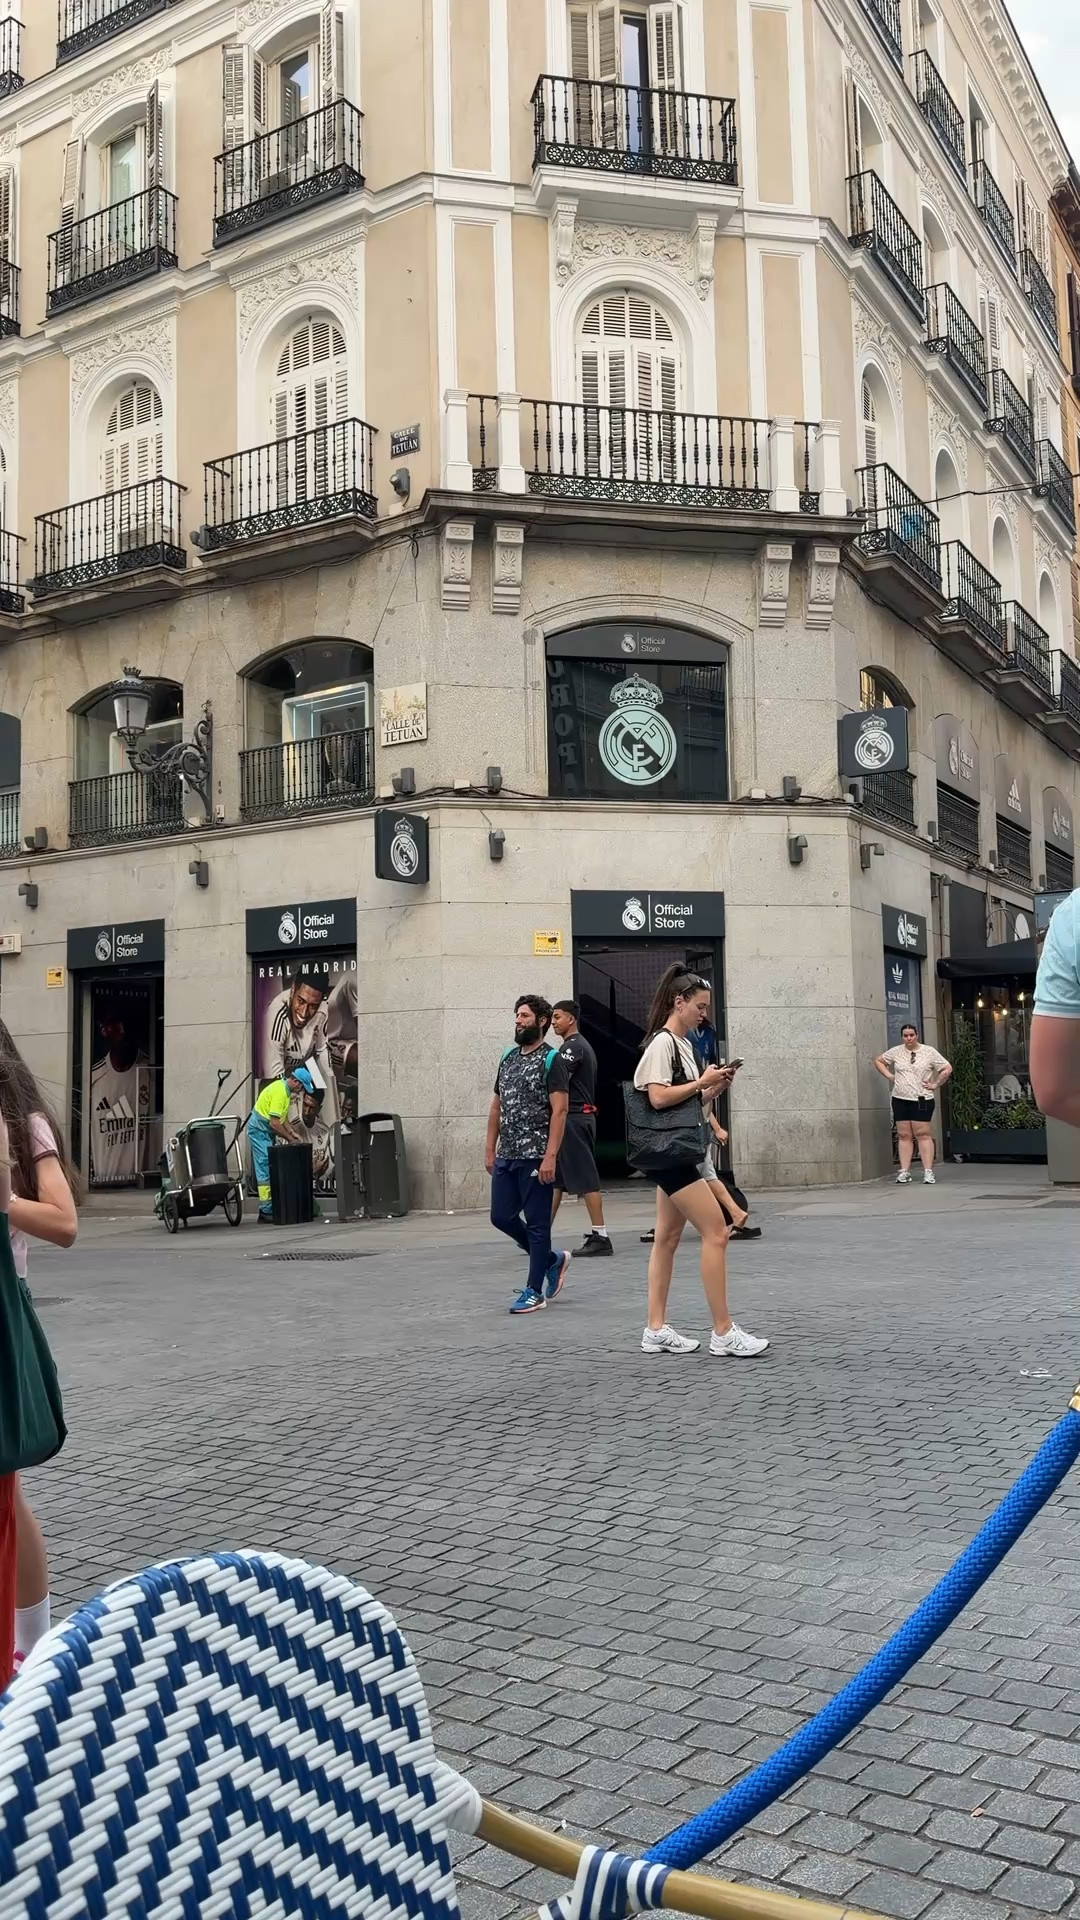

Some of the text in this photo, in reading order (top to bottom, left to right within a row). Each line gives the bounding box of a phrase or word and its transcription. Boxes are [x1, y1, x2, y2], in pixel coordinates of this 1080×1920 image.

[394, 427, 415, 439] CALLE
[641, 644, 661, 653] Store
[386, 718, 421, 731] CALLE DE
[384, 727, 424, 743] TETUAN
[654, 903, 693, 916] Official
[303, 913, 335, 927] Official
[654, 916, 686, 929] Store
[116, 932, 144, 946] Official
[303, 928, 329, 940] Store
[116, 946, 138, 958] Store
[259, 960, 357, 979] REAL MADRID
[119, 1128, 145, 1145] BETTR
